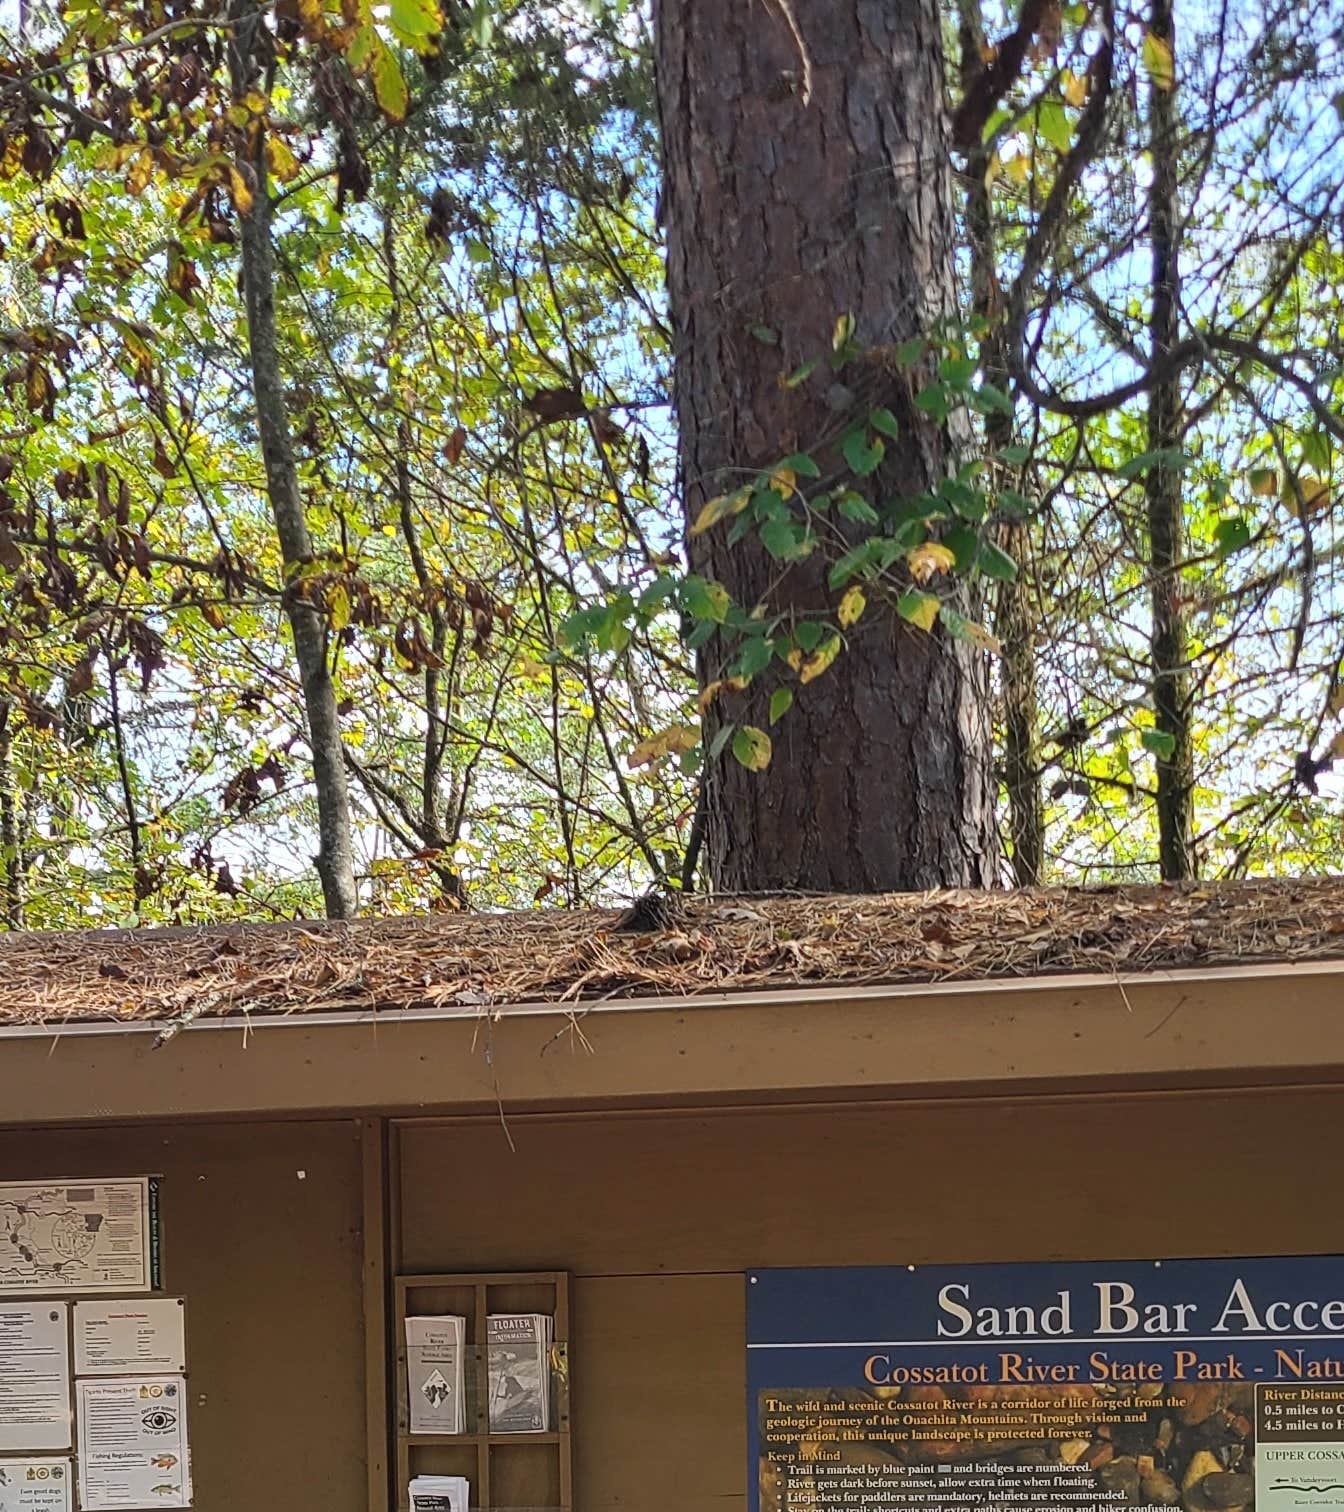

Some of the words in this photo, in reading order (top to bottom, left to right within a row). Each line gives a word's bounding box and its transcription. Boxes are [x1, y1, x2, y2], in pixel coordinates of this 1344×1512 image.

[937, 1284, 1074, 1336] Sand
[1093, 1282, 1197, 1334] Bar
[494, 1319, 531, 1329] FLOATER
[864, 1355, 989, 1384] Cossatot
[998, 1353, 1080, 1382] River
[1089, 1352, 1163, 1380] State
[1173, 1350, 1244, 1379] Park
[1264, 1389, 1298, 1400] River
[765, 1400, 792, 1412] The
[796, 1400, 820, 1411] wild
[824, 1399, 845, 1411] and
[848, 1399, 884, 1411] scenic
[887, 1398, 938, 1410] Cossatot
[943, 1398, 975, 1410] River
[977, 1398, 988, 1409] is
[991, 1401, 998, 1409] a
[1000, 1397, 1051, 1409] corridor
[1054, 1397, 1067, 1408] of
[1069, 1397, 1089, 1408] life
[1091, 1396, 1130, 1412] forged
[1134, 1396, 1163, 1407] from
[1166, 1396, 1186, 1407] the
[1264, 1405, 1283, 1416] 0.5
[1286, 1404, 1318, 1415] miles
[1322, 1405, 1333, 1415] to
[766, 1415, 816, 1430] geologic
[817, 1416, 862, 1430] journey
[865, 1414, 879, 1425] of
[881, 1414, 900, 1425] the
[903, 1413, 956, 1425] Ouachita
[960, 1412, 1027, 1424] Mountains.
[1030, 1412, 1082, 1427] Through
[1085, 1411, 1121, 1423] vision
[1124, 1411, 1147, 1422] and
[1264, 1420, 1283, 1431] 4.5
[1285, 1419, 1318, 1430] miles
[1322, 1420, 1333, 1430] to
[766, 1429, 840, 1445] cooperation,
[843, 1429, 865, 1440] this
[868, 1429, 908, 1444] unique
[912, 1428, 971, 1443] landscape
[974, 1428, 984, 1439] is
[987, 1427, 1045, 1443] protected
[1048, 1427, 1093, 1438] forever.
[767, 1451, 795, 1465] Keep
[798, 1451, 809, 1461] in
[810, 1451, 841, 1461] Mind
[1266, 1451, 1305, 1461] UPPER
[788, 1464, 813, 1474] Trail
[815, 1464, 825, 1474] is
[827, 1464, 865, 1474] marked
[867, 1463, 881, 1477] by
[882, 1463, 905, 1474] blue
[907, 1463, 935, 1477] paint
[953, 1463, 972, 1473] and
[975, 1462, 1014, 1476] bridges
[1017, 1465, 1032, 1473] are
[1035, 1462, 1092, 1473] numbered.
[787, 1478, 815, 1488] River
[817, 1479, 838, 1491] gets
[840, 1477, 864, 1488] dark
[866, 1477, 898, 1488] before
[900, 1478, 937, 1489] sunset,
[938, 1477, 966, 1487] allow
[968, 1478, 995, 1487] extra
[997, 1477, 1021, 1487] time
[1023, 1476, 1051, 1487] when
[1053, 1476, 1098, 1490] floating.
[787, 1491, 841, 1505] Lifejackets
[844, 1491, 859, 1501] for
[861, 1491, 905, 1505] paddlers
[927, 1490, 986, 1504] mandatory,
[988, 1490, 1029, 1501] helmets
[1050, 1489, 1128, 1500] recommended.
